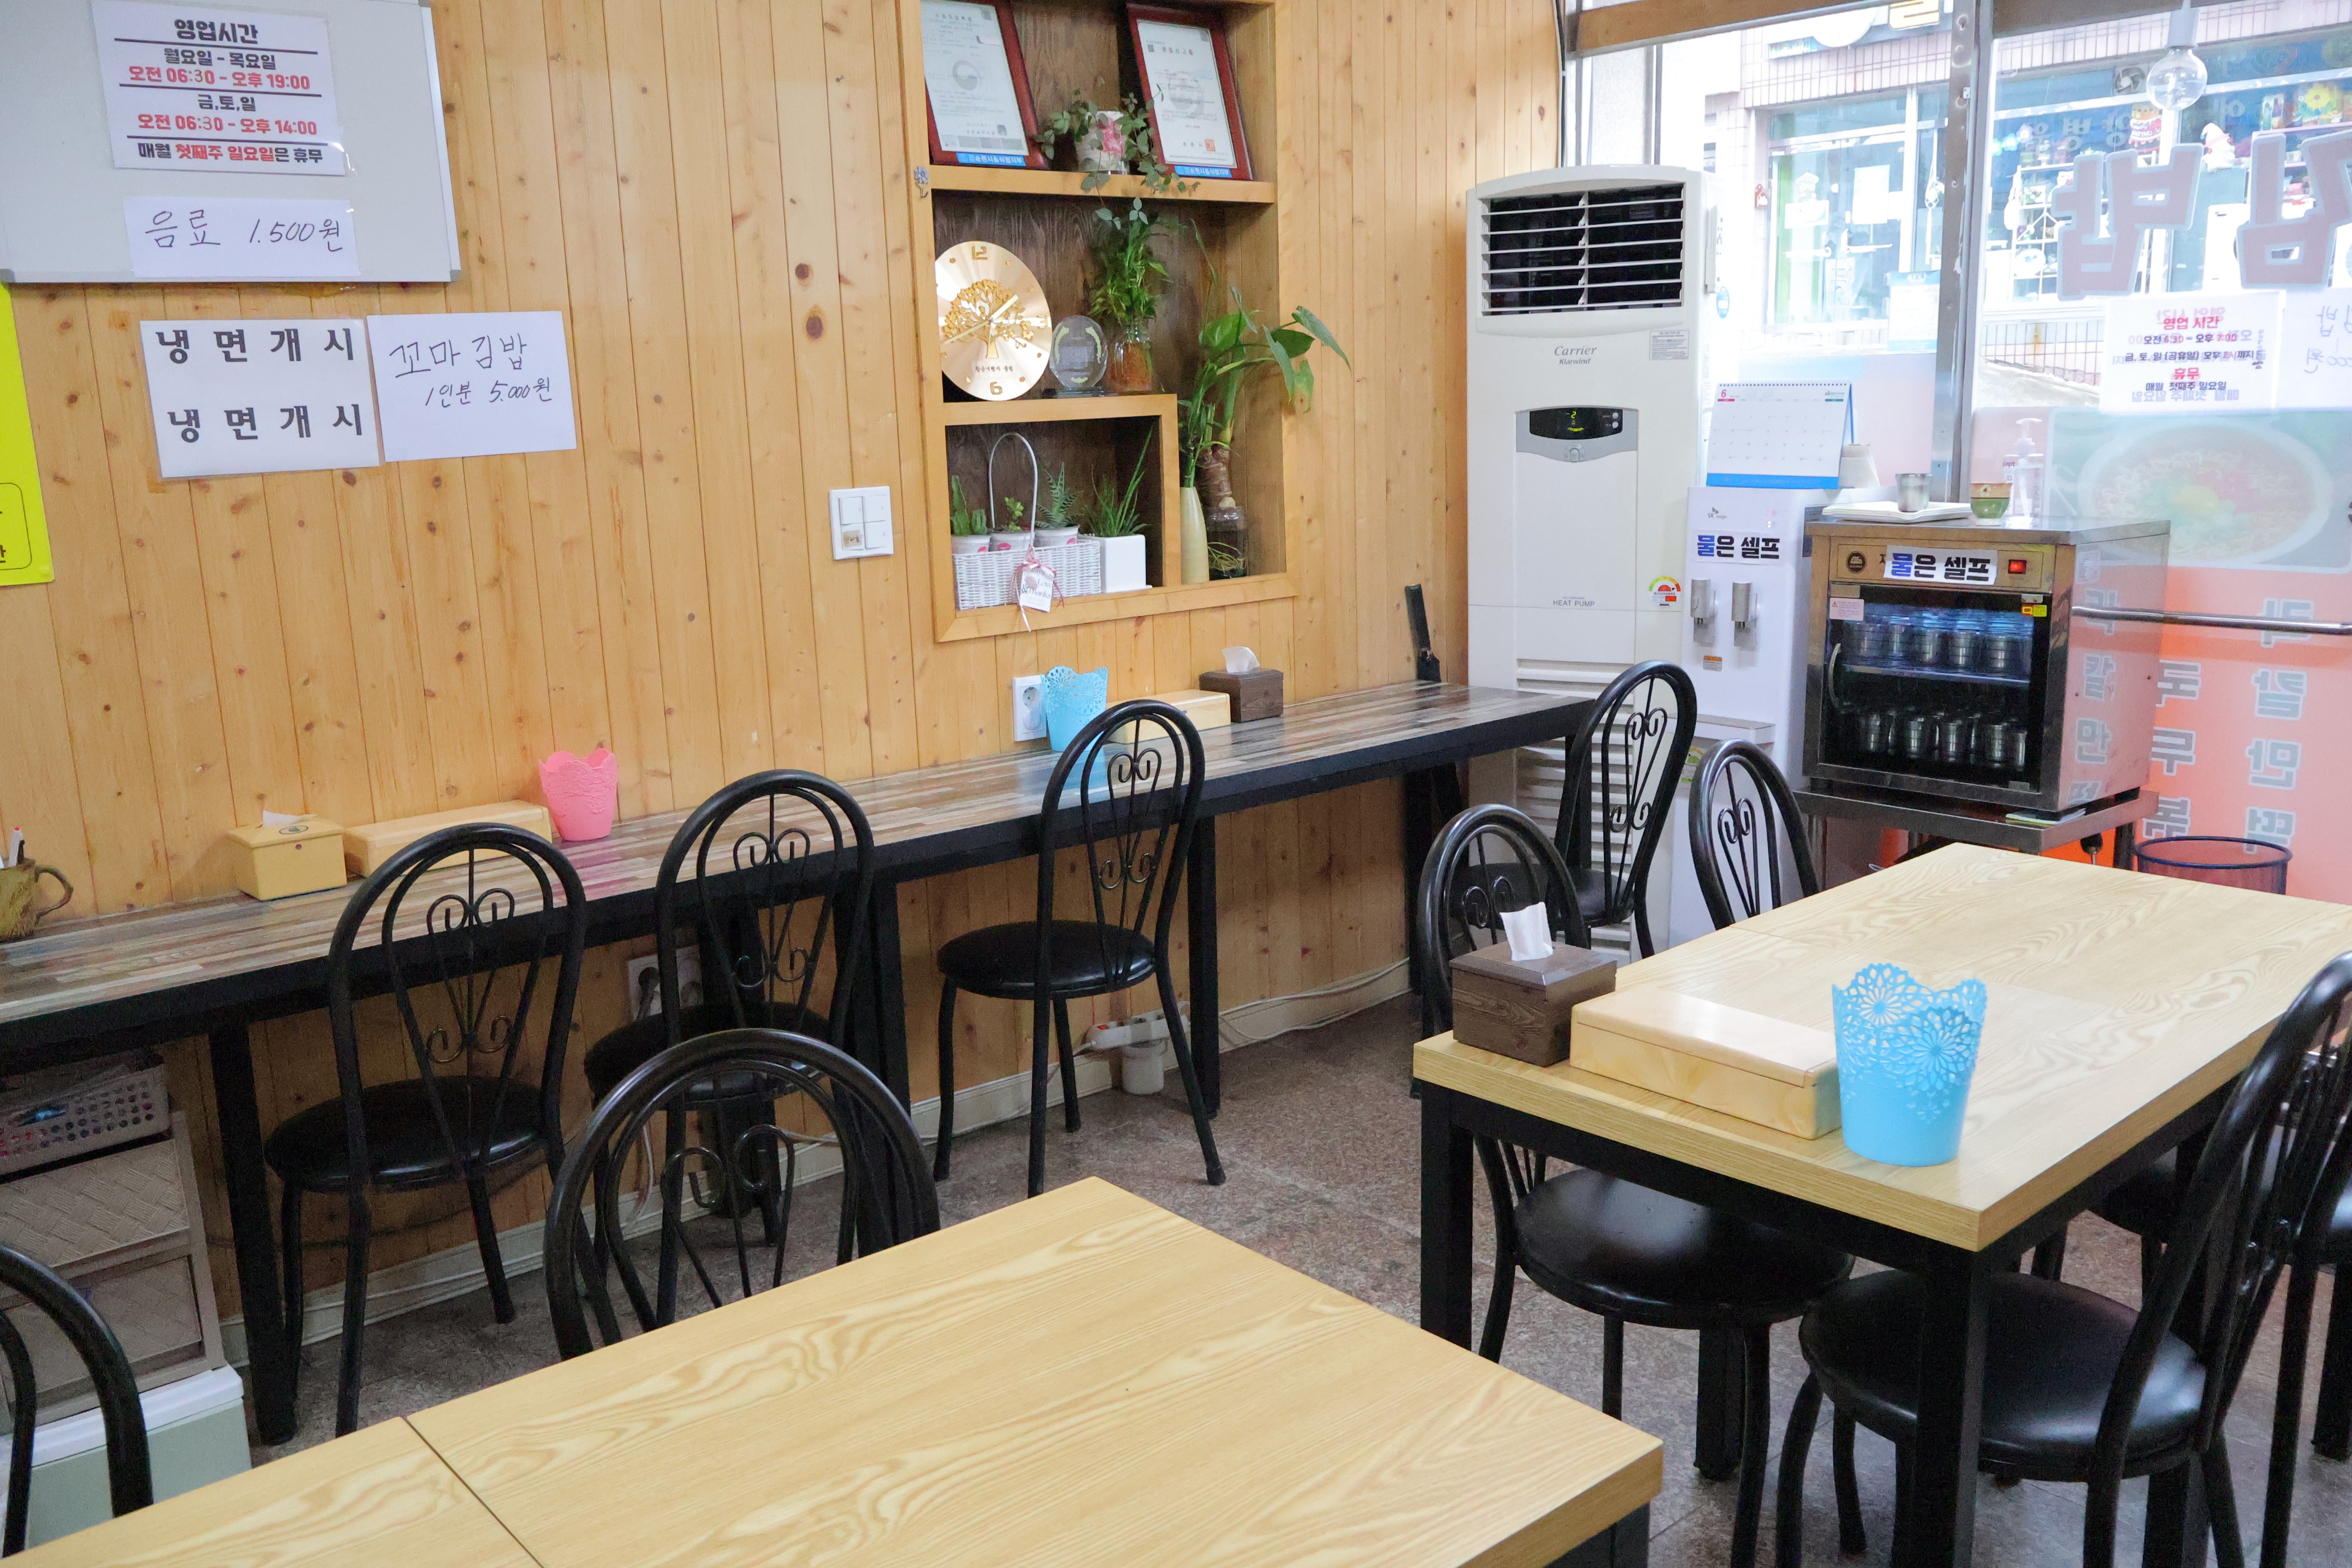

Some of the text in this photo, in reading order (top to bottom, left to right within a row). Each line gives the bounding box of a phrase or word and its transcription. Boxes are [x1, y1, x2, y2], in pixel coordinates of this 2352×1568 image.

[174, 19, 259, 45] 영업시간
[164, 48, 212, 67] 월요일
[229, 52, 277, 71] 목요일
[129, 65, 162, 83] 오전
[167, 68, 215, 86] 06:30
[232, 70, 263, 89] 오후
[267, 74, 311, 91] 19:00
[197, 94, 257, 113] 금,토,일
[138, 114, 172, 131] 오전
[175, 115, 224, 133] 06:30
[241, 119, 271, 136] 오후
[275, 120, 318, 137] 14:00
[137, 143, 323, 165] 매월 첫째주 일요일은 휴무
[145, 209, 221, 249] 음료
[2163, 316, 2220, 330] 영업 시간
[2143, 334, 2161, 344] 오전
[2196, 334, 2213, 343] 오후
[1554, 345, 1597, 356] Carrier
[2204, 351, 2221, 360] 오후
[2223, 350, 2254, 360] 2시까지
[2174, 368, 2200, 380] 휴무
[990, 381, 1003, 395] 6
[1721, 389, 1727, 397] 6
[2146, 382, 2227, 391] 매월 첫째주 일요일
[425, 384, 473, 409] 1인분
[1697, 535, 1780, 559] 물은 셀프
[1891, 552, 1991, 582] 물은 셀프
[1038, 578, 1053, 588] Love
